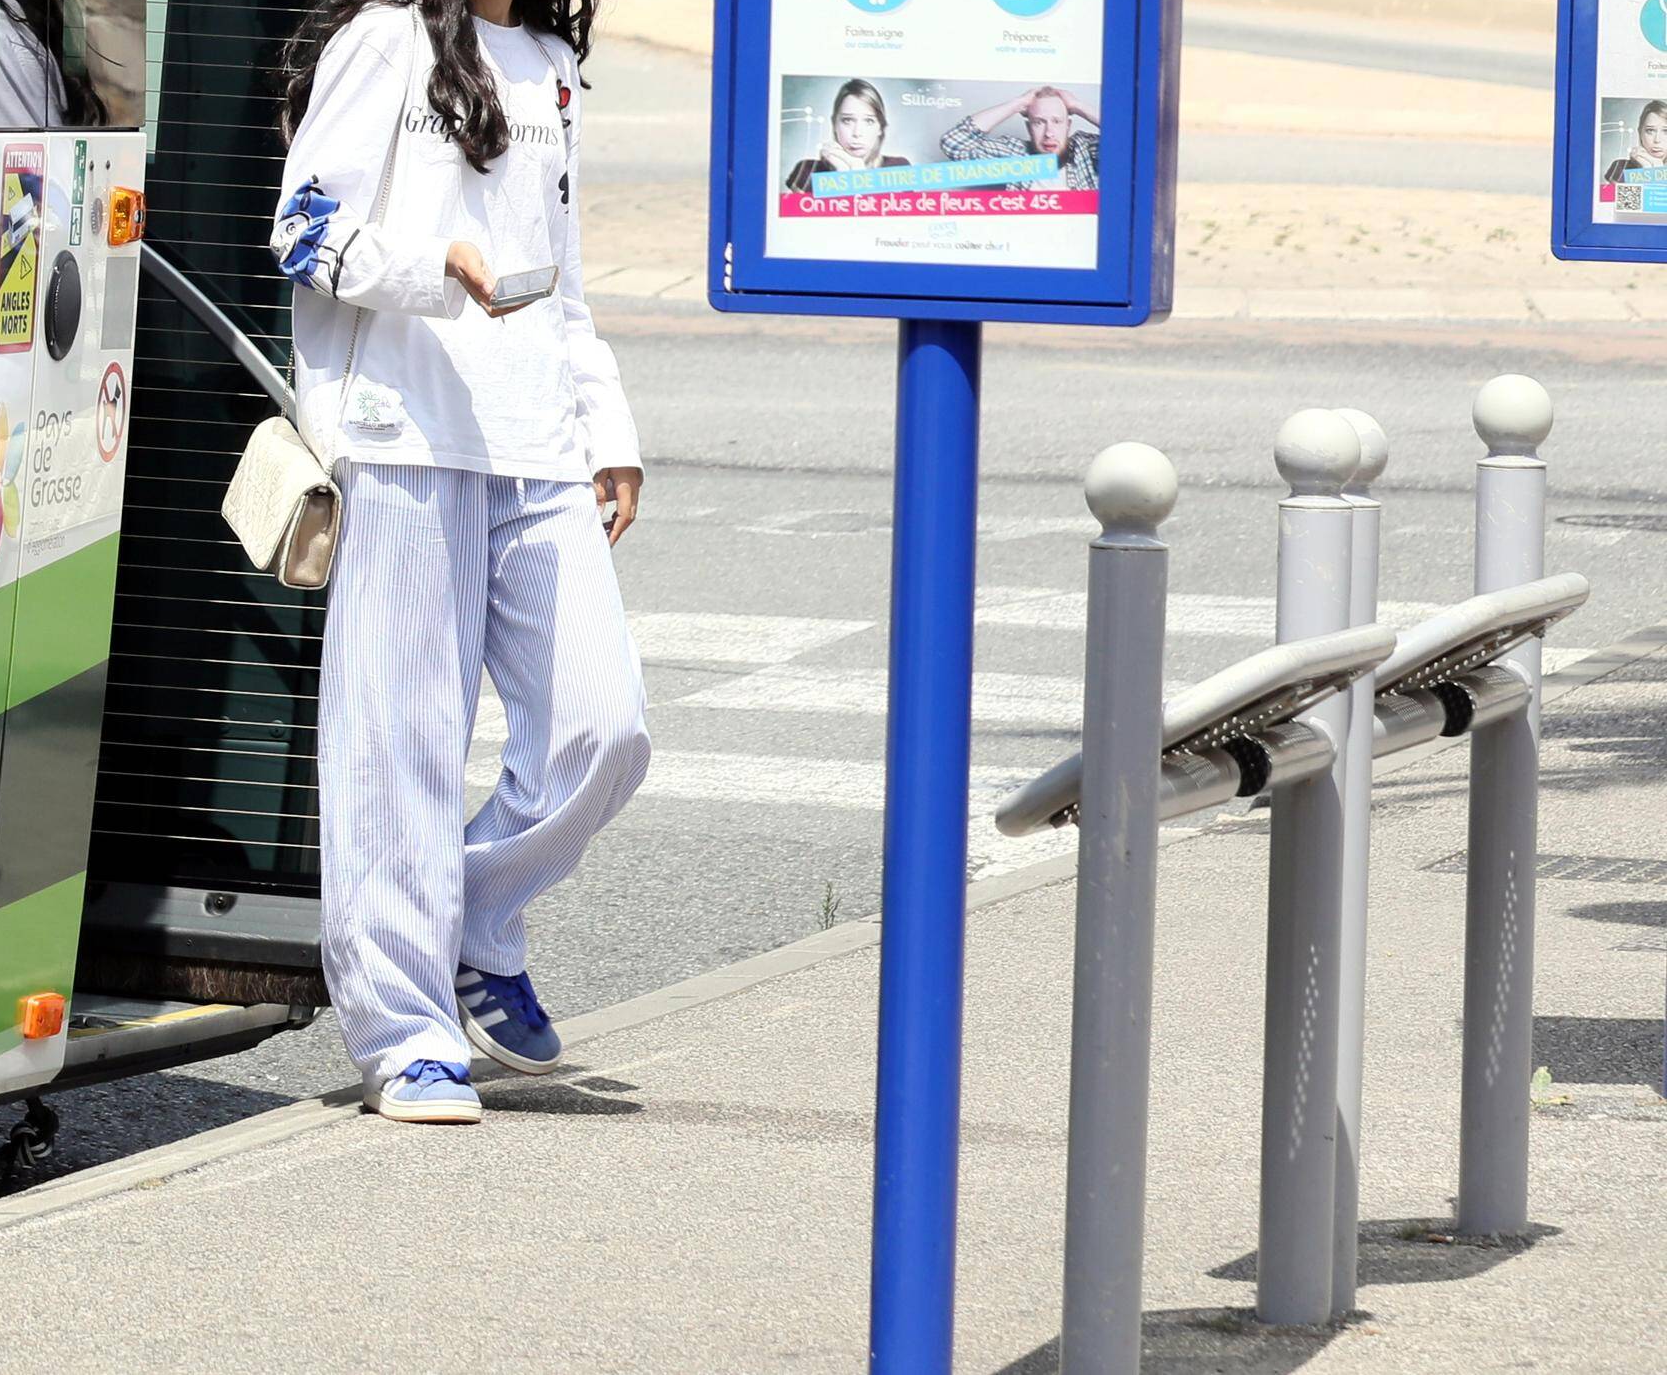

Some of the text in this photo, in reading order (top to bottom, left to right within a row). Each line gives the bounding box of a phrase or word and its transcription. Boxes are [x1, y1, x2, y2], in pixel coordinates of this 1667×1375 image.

[845, 25, 904, 41] Faites signe
[1002, 29, 1050, 44] Préparez
[901, 92, 963, 109] Sillages
[5, 150, 43, 169] ATTENTION
[818, 174, 848, 192] PAS
[852, 173, 873, 190] DE
[877, 169, 917, 188] TITRE
[922, 167, 943, 184] DE
[948, 158, 1043, 182] TRANSPORT
[1629, 169, 1652, 182] PAS
[799, 193, 1063, 216] On ne fait plus de fleurs, c'est 45€.
[0, 291, 31, 312] ANGLES
[0, 314, 29, 335] MORTS
[35, 409, 73, 447] Pays
[33, 441, 52, 474] de
[30, 475, 82, 508] Grasse
